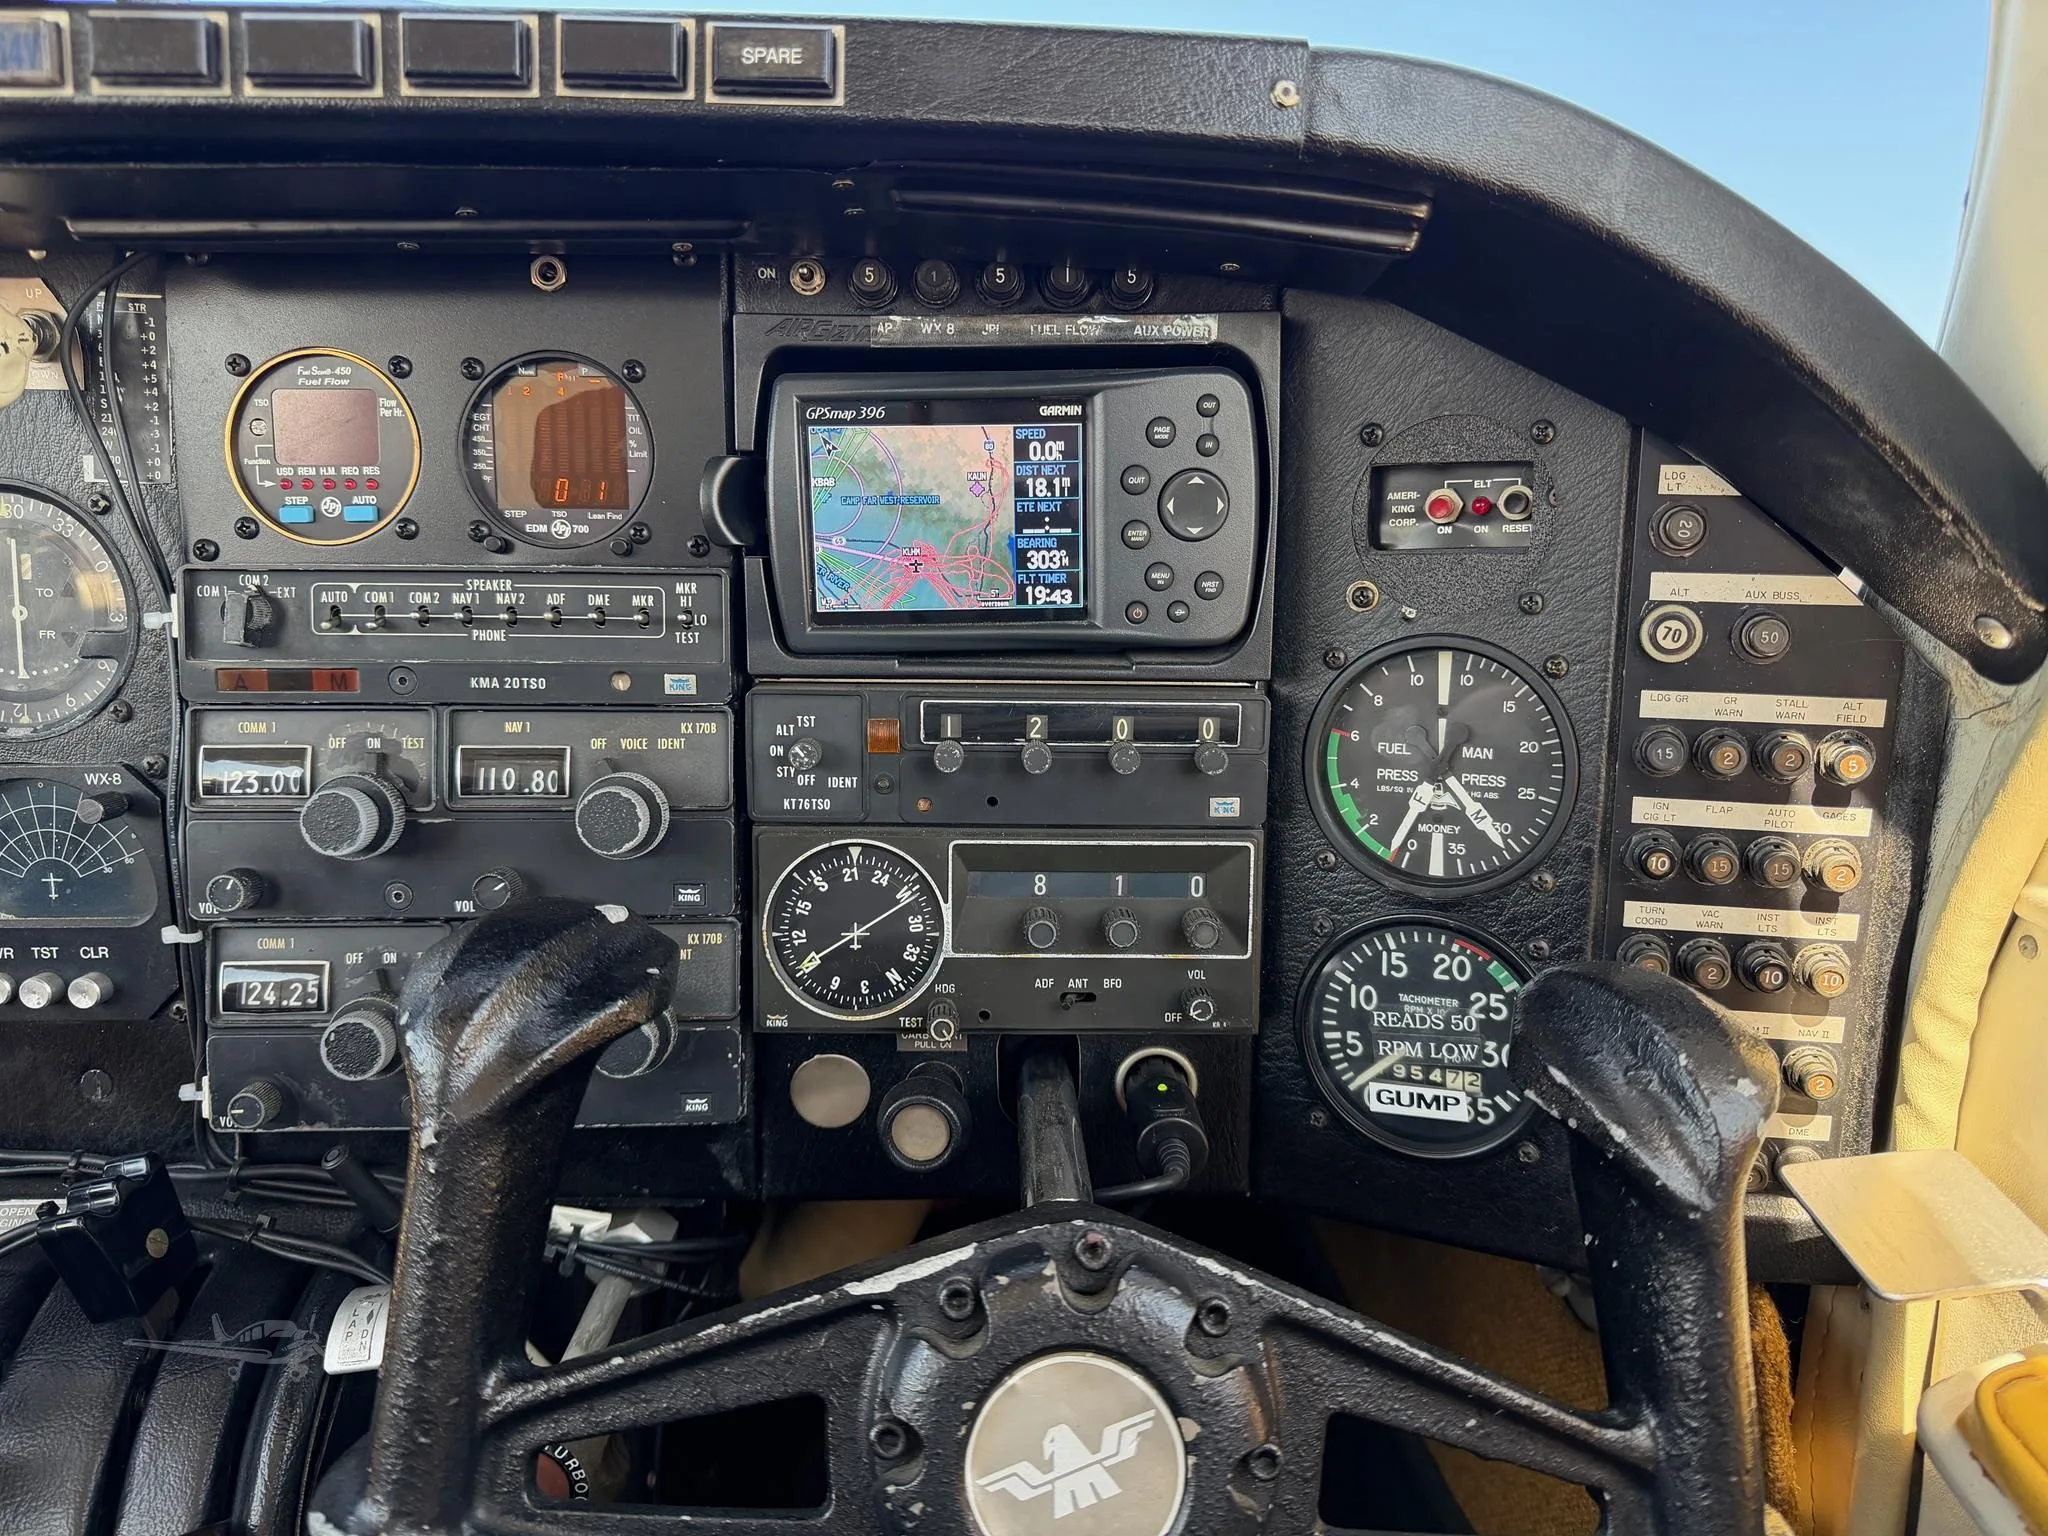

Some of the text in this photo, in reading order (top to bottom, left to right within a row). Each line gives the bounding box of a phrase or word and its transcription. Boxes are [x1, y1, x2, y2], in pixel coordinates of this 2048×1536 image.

[741, 48, 802, 64] SPARE
[758, 268, 776, 279] ON
[25, 288, 42, 298] UP
[128, 303, 146, 312] STR
[1134, 325, 1209, 337] AUX POWER
[806, 407, 885, 420] GPSmap 396
[1040, 405, 1082, 416] GARMIN
[1016, 429, 1045, 439] SPEED
[277, 467, 293, 475] USD
[298, 467, 315, 475] REM
[341, 467, 359, 475] REQ
[363, 467, 380, 475] RES
[1016, 465, 1065, 475] DIST NEXT
[1664, 472, 1685, 480] LDG
[812, 478, 835, 486] KBAB
[1474, 480, 1492, 488] ELT
[1667, 483, 1681, 491] LT
[352, 496, 376, 504] AUTO
[900, 496, 940, 504] RESERVOIR
[1017, 502, 1061, 512] ETE NEXT
[1437, 526, 1452, 534] ON
[1018, 538, 1056, 548] BEARING
[1018, 573, 1066, 584] FLT TIMER
[466, 579, 512, 591] SPEAKER
[676, 583, 697, 593] MKR
[36, 589, 53, 598] TO
[277, 587, 296, 598] EXT
[321, 591, 348, 603] AUTO
[365, 592, 394, 603] COM 1
[1026, 586, 1072, 605] 19:43
[1745, 591, 1799, 600] AUX BUSS
[409, 592, 440, 604] COM 2
[453, 593, 479, 604] NAV 1
[497, 593, 525, 604] NAV 2
[547, 594, 565, 605] ADF
[588, 594, 610, 606] DME
[632, 595, 654, 606] MKR
[680, 596, 692, 607] HI
[39, 631, 55, 639] FR
[473, 630, 506, 641] PHONE
[675, 632, 699, 644] TEST
[1663, 626, 1682, 643] 70
[1650, 694, 1688, 703] LDG GR
[1723, 697, 1737, 705] GR
[1776, 699, 1808, 708] STALL
[1843, 702, 1863, 710] ALT
[1715, 709, 1743, 717] WARN
[1776, 711, 1806, 720] WARN
[797, 716, 816, 727] TST
[1837, 715, 1867, 723] FIELD
[504, 722, 530, 732] NAV 1
[681, 723, 717, 733] KX 170B
[776, 725, 794, 735] ALT
[329, 738, 346, 749] OFF
[367, 738, 381, 749] ON
[402, 738, 424, 749] TEST
[591, 739, 607, 749] OFF
[621, 739, 648, 749] VOICE
[658, 739, 685, 749] IDENT
[1377, 743, 1411, 754] FUEL
[770, 746, 783, 756] ON
[1462, 748, 1493, 759] MAN
[85, 773, 121, 785] WX-8
[479, 767, 558, 793] 110.80
[797, 775, 815, 785] OFF
[1377, 770, 1418, 781] PRESS
[1462, 774, 1506, 787] PRESS
[828, 777, 857, 788] IDENT
[1706, 805, 1733, 813] FLAP
[1768, 809, 1795, 818] AUTO
[1643, 813, 1676, 822] CIG LT
[1823, 812, 1856, 821] GAGES
[1418, 824, 1460, 834] MOONEY
[1764, 820, 1794, 828] PILOT
[678, 893, 700, 902] KING
[455, 901, 475, 912] VOL
[1639, 906, 1665, 915] TURN
[1701, 910, 1720, 919] VAC
[1757, 913, 1779, 922] INST
[1635, 917, 1668, 926] COORD
[1696, 921, 1723, 929] WARN
[1816, 917, 1837, 925] INST
[1758, 924, 1777, 932] LTS
[1817, 928, 1837, 936] LTS
[257, 938, 294, 949] COMM 1
[688, 933, 722, 944] KX 170B
[31, 948, 59, 958] TST
[80, 948, 109, 958] CLR
[346, 953, 363, 963] OFF
[384, 953, 397, 963] ON
[1433, 954, 1472, 981] 20
[1187, 970, 1206, 980] VOL
[1035, 978, 1054, 989] ADF
[1068, 979, 1088, 989] ANT
[1104, 979, 1121, 989] BFO
[241, 981, 318, 1005] 124.25
[935, 985, 955, 993] HDG
[1350, 984, 1378, 1011] 10
[1399, 994, 1458, 1007] TACHOMETER
[900, 1017, 923, 1027] TEST
[1165, 1013, 1182, 1023] OFF
[1373, 1012, 1476, 1031] READS 50
[1378, 1041, 1422, 1058] RPM
[1430, 1043, 1479, 1059] LOW
[1376, 1090, 1460, 1111] GUMP
[685, 1103, 708, 1111] KING
[1789, 1127, 1809, 1136] DME
[0, 1208, 34, 1216] OPEN
